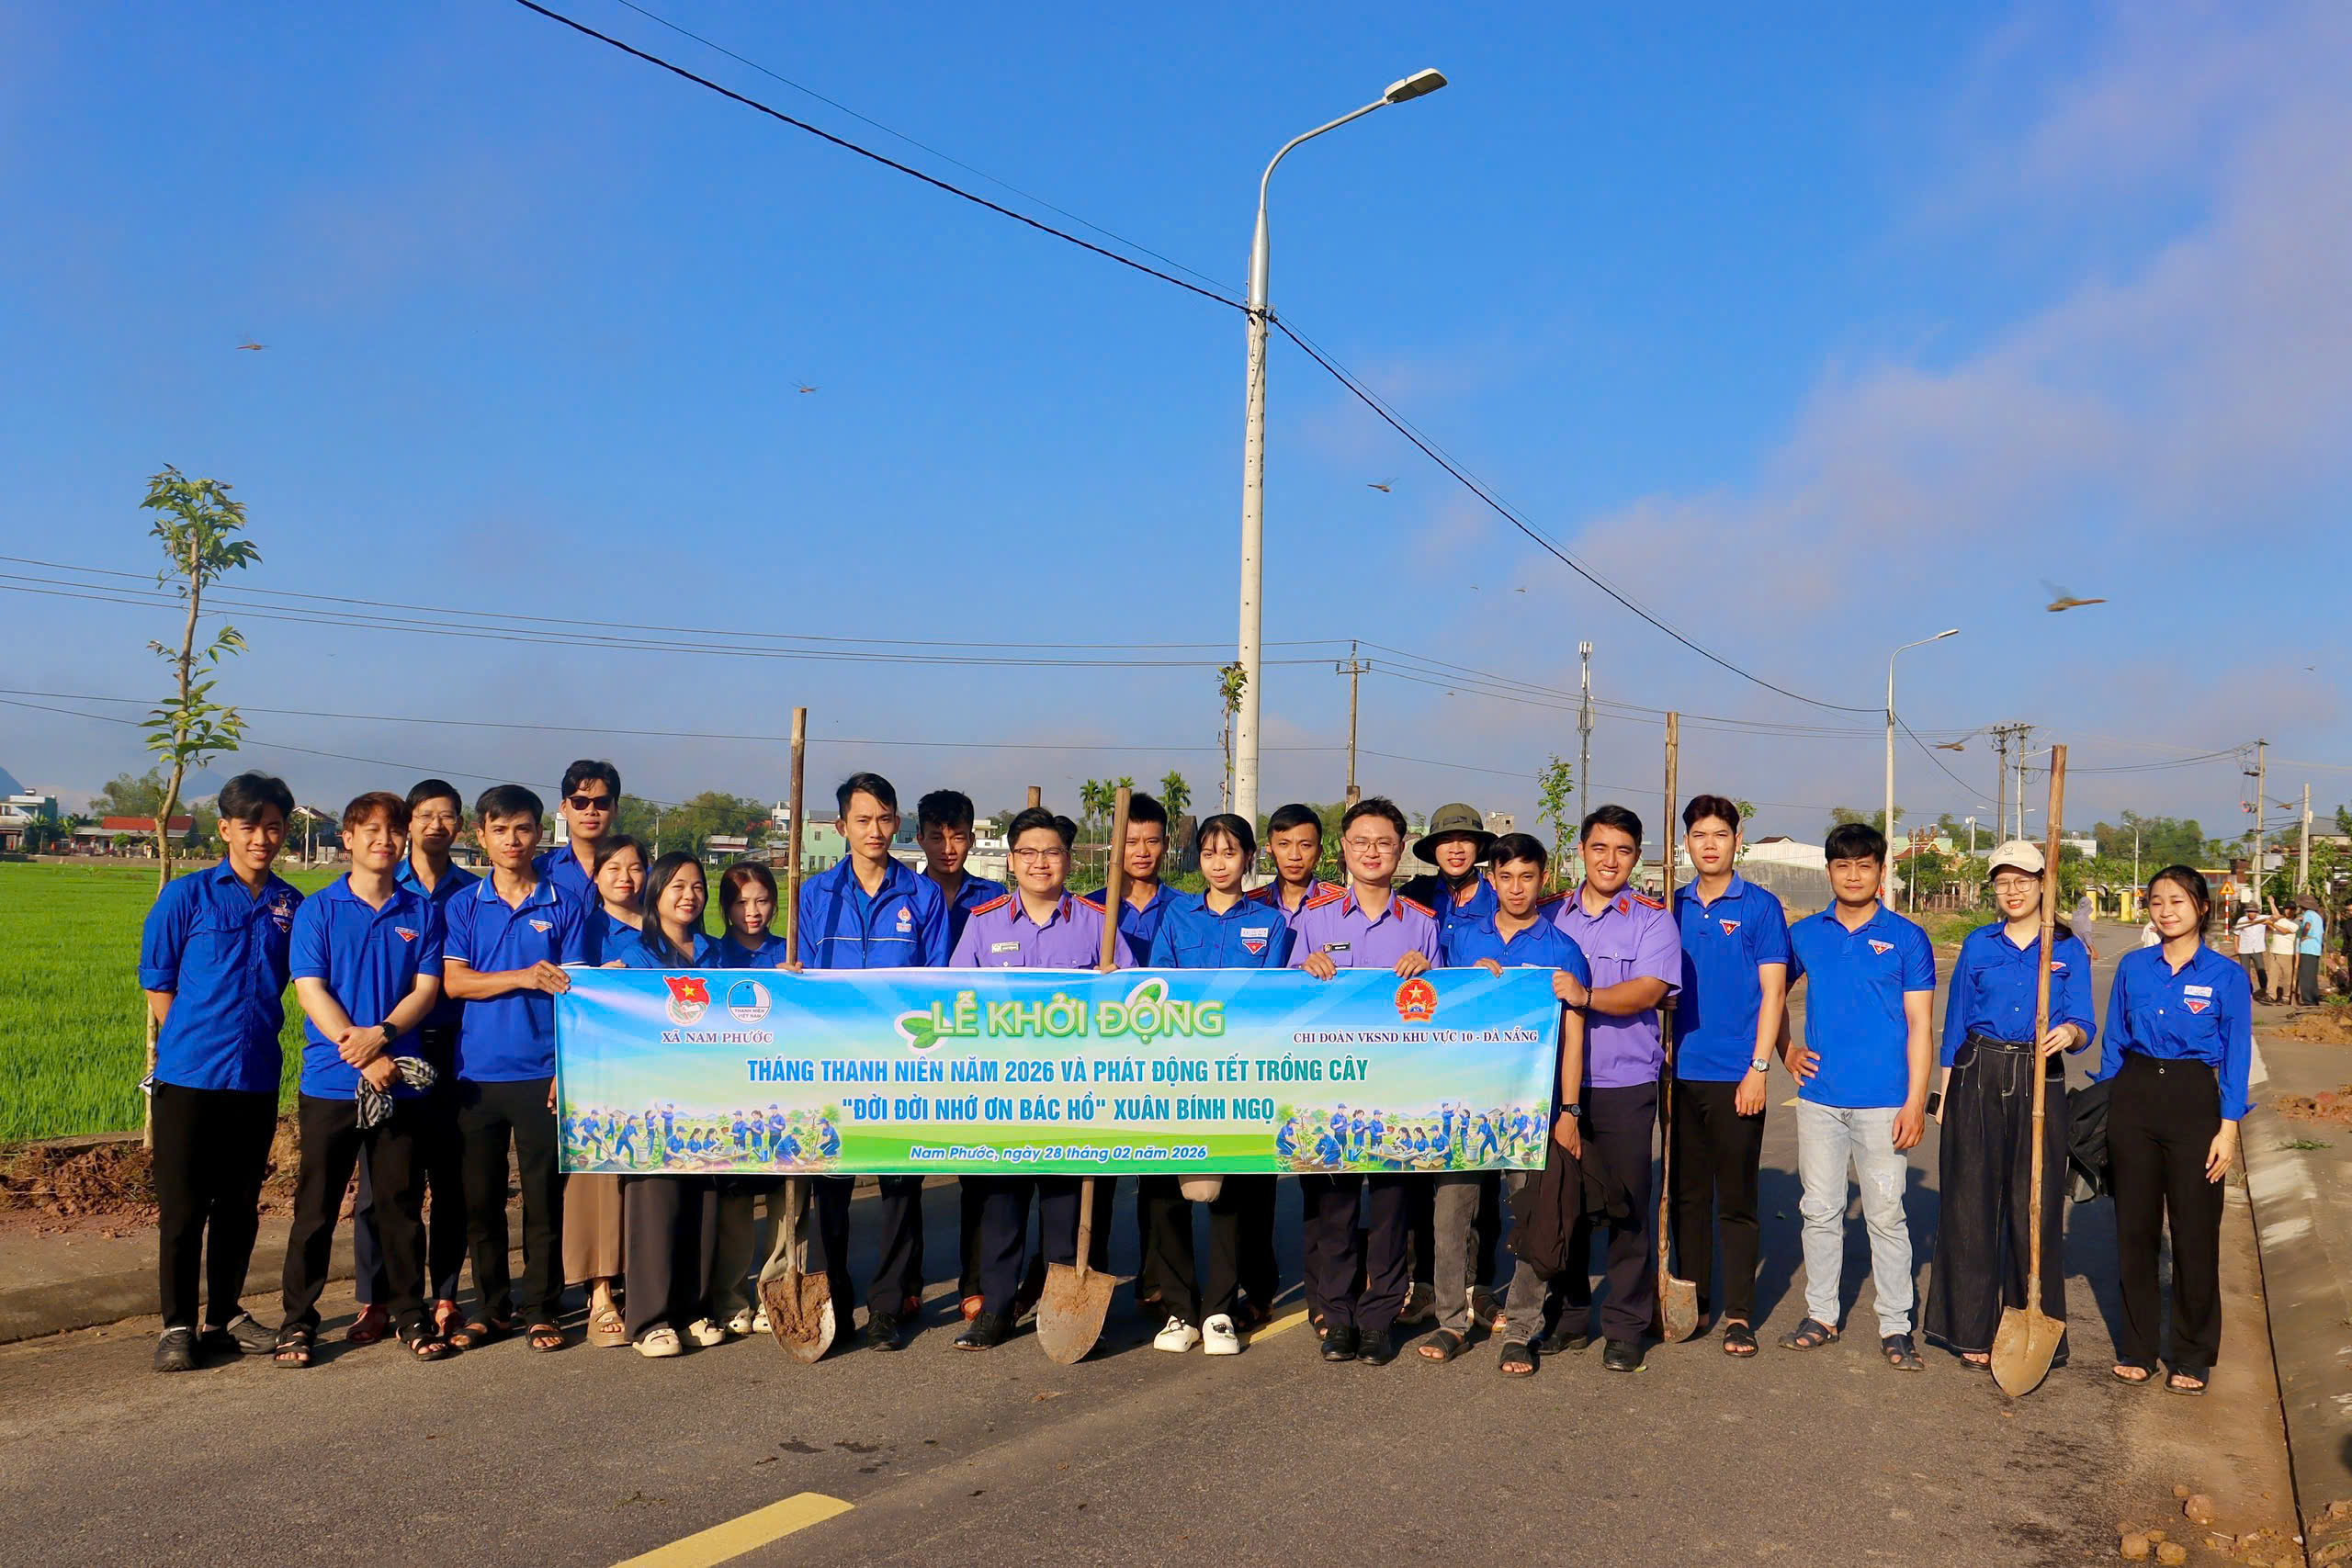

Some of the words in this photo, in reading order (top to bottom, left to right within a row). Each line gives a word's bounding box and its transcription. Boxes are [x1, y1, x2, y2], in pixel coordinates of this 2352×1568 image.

[932, 991, 978, 1036] LỄ
[987, 992, 1088, 1037] KHỞI
[1095, 995, 1225, 1043] ĐỘNG
[662, 1031, 681, 1043] XÃ
[685, 1032, 718, 1043] NAM
[722, 1030, 773, 1043] PHƯỚC
[1294, 1032, 1315, 1043] CHI
[1319, 1031, 1354, 1043] ĐOÀN
[1359, 1032, 1398, 1043] VKSND
[1403, 1032, 1429, 1042] KHU
[1433, 1030, 1457, 1043] VỰC
[1461, 1032, 1473, 1042] 10
[1484, 1029, 1500, 1042] ĐÀ
[1504, 1026, 1538, 1042] NẴNG
[747, 1055, 814, 1081] THÁNG
[820, 1060, 888, 1082] THANH
[895, 1056, 944, 1082] NIÊN
[951, 1056, 998, 1082] NĂM
[1005, 1061, 1054, 1082] 2026
[1060, 1056, 1087, 1082] VÀ
[1093, 1056, 1146, 1082] PHÁT
[1152, 1055, 1208, 1087] ĐỘNG
[1215, 1053, 1250, 1081] TẾT
[1256, 1052, 1323, 1081] TRỒNG
[1329, 1055, 1368, 1081] CÂY
[842, 1093, 888, 1120] "ĐỜI
[894, 1093, 928, 1120] ĐỜI
[935, 1094, 978, 1120] NHỚ
[984, 1097, 1012, 1120] ƠN
[1020, 1094, 1060, 1120] BÁC
[1068, 1091, 1106, 1120] HỒ"
[1114, 1094, 1170, 1120] XUÂN
[1176, 1094, 1227, 1120] BÍNH
[1232, 1098, 1274, 1124] NGỌ
[910, 1147, 945, 1159] Nam
[949, 1145, 999, 1161] Phước,
[1002, 1146, 1041, 1163] ngày
[1044, 1147, 1062, 1159] 28
[1066, 1145, 1109, 1163] tháng
[1113, 1146, 1131, 1159] 02
[1134, 1146, 1168, 1159] năm
[1171, 1146, 1207, 1159] 2026
